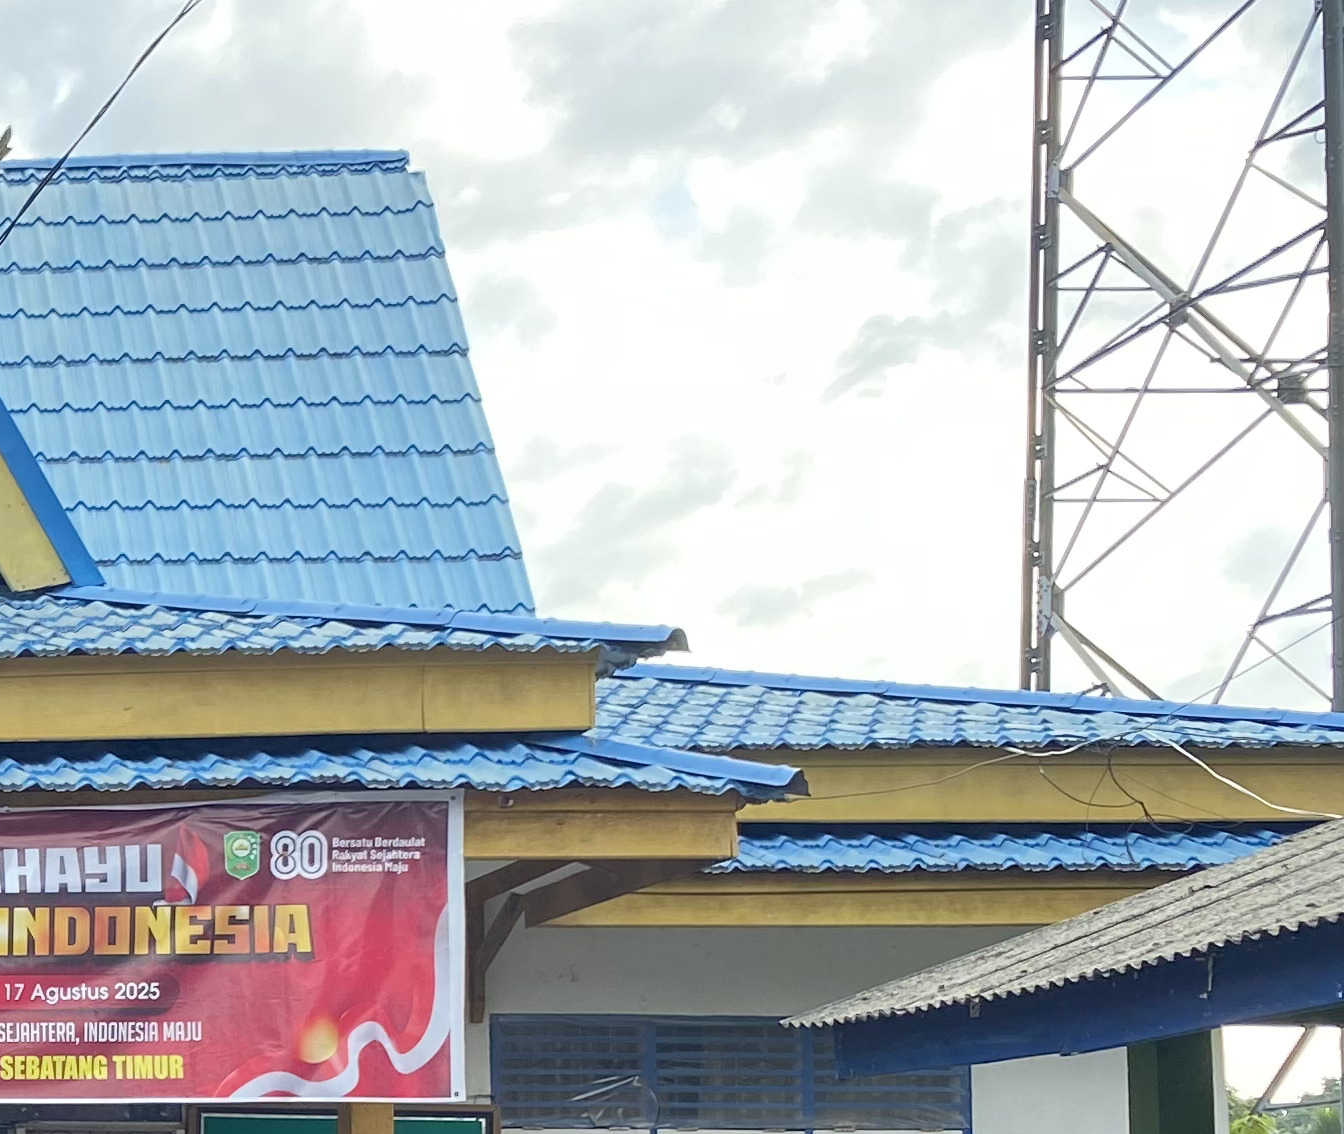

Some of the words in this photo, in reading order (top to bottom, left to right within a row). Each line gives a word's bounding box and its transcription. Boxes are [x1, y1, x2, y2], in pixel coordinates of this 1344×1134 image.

[331, 837, 373, 848] Bersatu
[374, 836, 426, 848] Berdaulat
[270, 830, 328, 880] 80
[331, 849, 369, 863] Rakyat
[369, 848, 422, 863] Sejahtera
[331, 862, 383, 873] Indonesia
[383, 862, 409, 875] Maju
[3, 983, 25, 1001] 17
[30, 982, 109, 1005] Agustus
[114, 982, 161, 1000] 2025
[83, 1021, 159, 1043] INDONESIA
[162, 1020, 203, 1042] MAJU
[0, 1054, 108, 1080] SEBATANG
[112, 1054, 185, 1080] TIMUR
